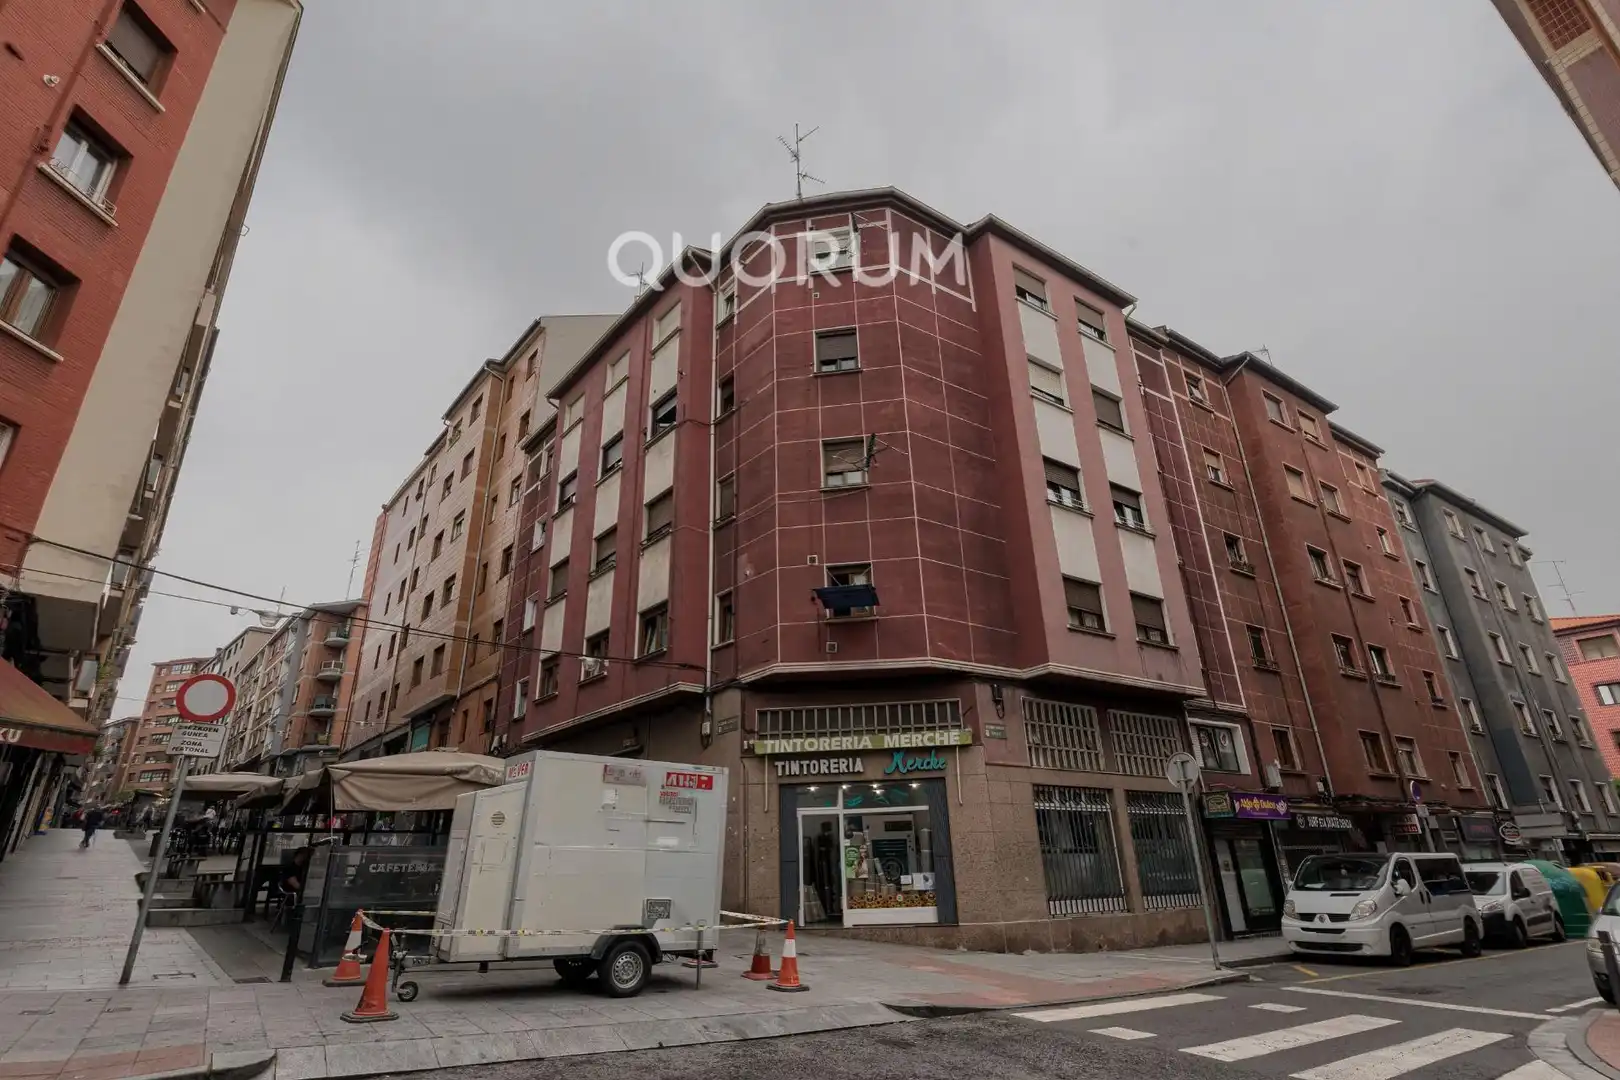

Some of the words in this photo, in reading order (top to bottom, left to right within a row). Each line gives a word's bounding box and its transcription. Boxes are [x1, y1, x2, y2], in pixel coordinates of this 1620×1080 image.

[764, 735, 873, 753] TINTORERIA
[884, 730, 961, 748] MERCHE
[775, 757, 864, 776] TINTORERIA
[884, 749, 947, 774] Merche
